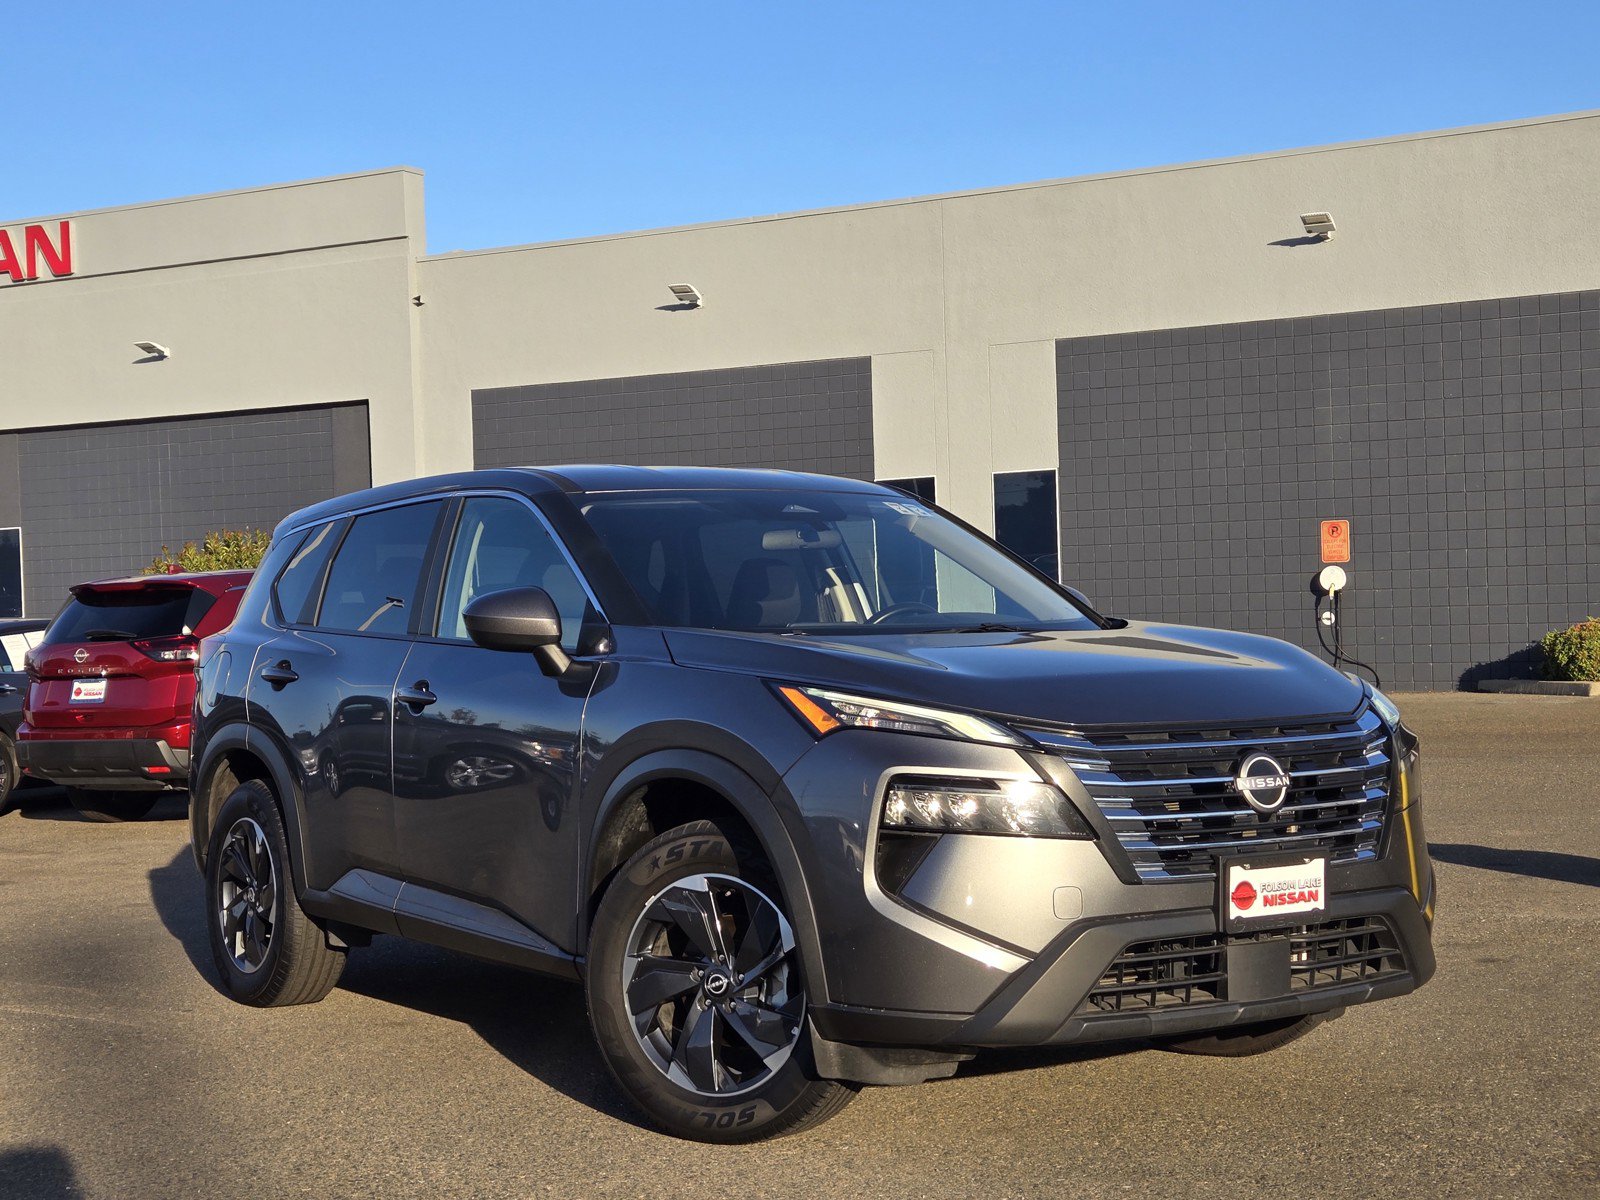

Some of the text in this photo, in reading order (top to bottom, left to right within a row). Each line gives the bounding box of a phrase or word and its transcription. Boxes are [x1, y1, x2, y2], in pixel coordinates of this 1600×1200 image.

[1240, 776, 1290, 788] NISSAN
[1260, 877, 1322, 893] FOLSOM LAKE
[1263, 889, 1319, 907] NISSAN
